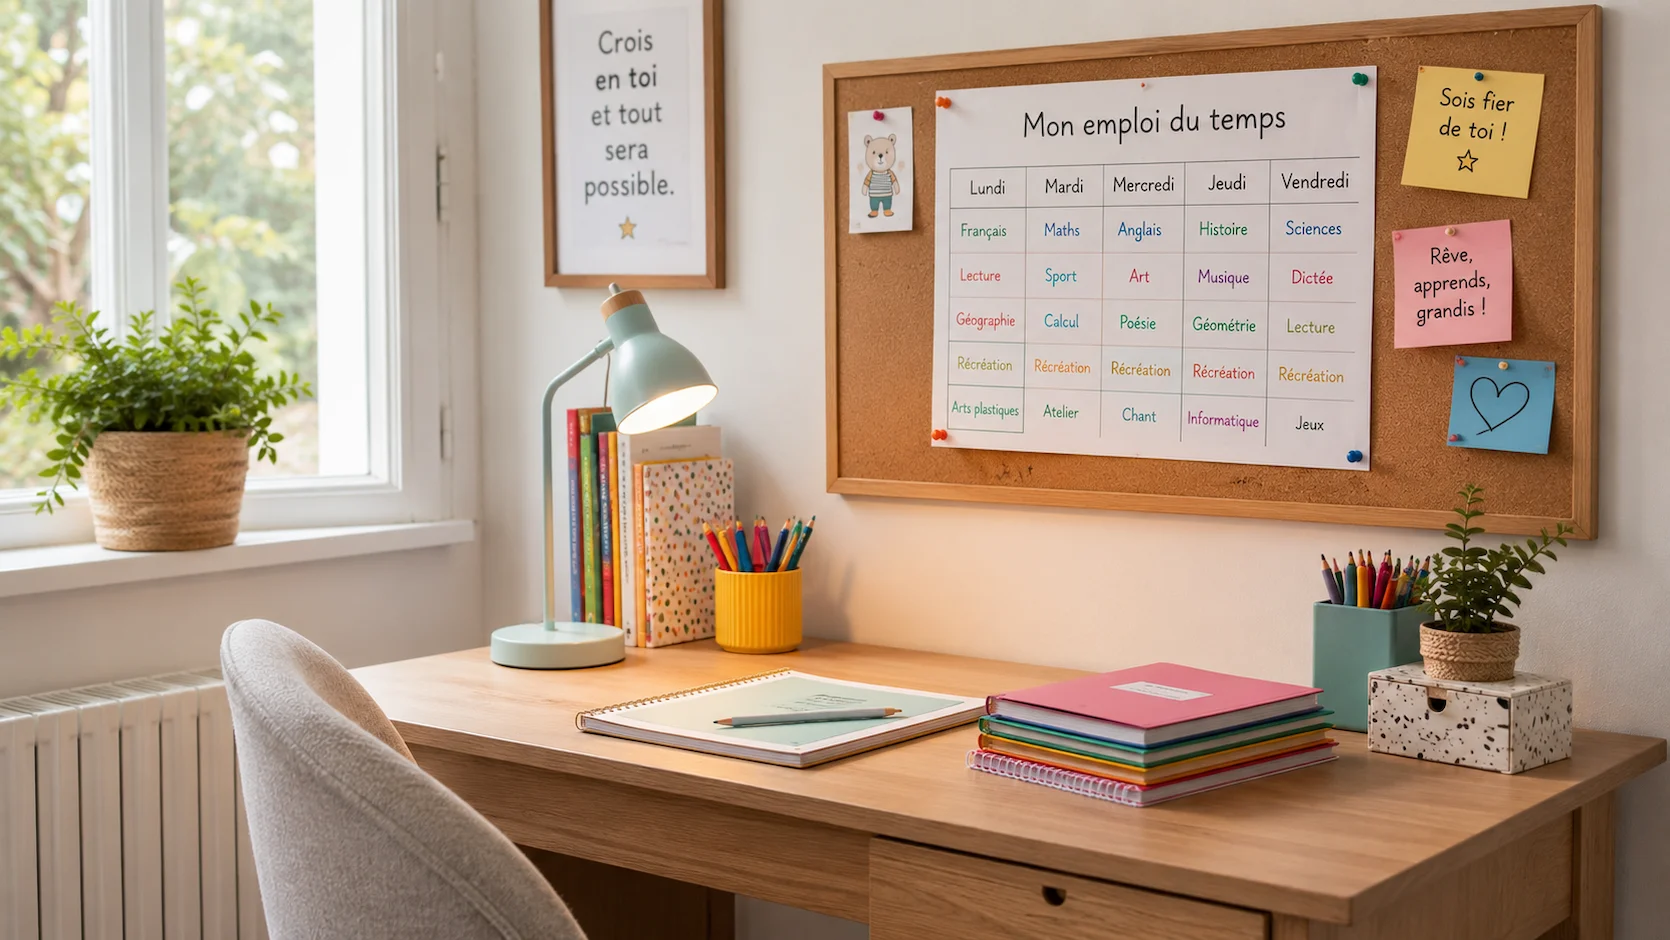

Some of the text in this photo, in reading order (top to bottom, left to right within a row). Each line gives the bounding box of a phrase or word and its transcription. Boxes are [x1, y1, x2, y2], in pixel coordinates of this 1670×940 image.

[598, 29, 653, 55] Crois
[596, 64, 656, 91] en toi
[1440, 88, 1514, 112] Sois fier
[591, 102, 662, 126] et tout
[1024, 104, 1285, 144] Mon emploi du temps
[1440, 116, 1507, 141] de toi !
[606, 143, 648, 161] sera
[585, 170, 674, 205] possible.
[971, 179, 1004, 195] Lundi
[1046, 177, 1083, 193] Mardi
[1114, 176, 1174, 192] Mercredi
[1208, 173, 1245, 190] Jeudi
[1282, 171, 1348, 189] Vendredi
[961, 223, 1006, 241] Français
[1045, 222, 1080, 236] Maths
[1118, 221, 1161, 242] Anglais
[1200, 221, 1247, 235] Histoire
[1286, 220, 1341, 235] Sciences
[1431, 247, 1472, 264] Rêve,
[960, 268, 1000, 281] Lecture
[1046, 268, 1076, 287] Sport
[1129, 269, 1149, 283] Art
[1199, 269, 1249, 289] Musique
[1292, 270, 1333, 284] Dictée
[1414, 270, 1491, 298] apprends,
[1417, 297, 1486, 326] grandis !
[956, 312, 1016, 331] Géographie
[1044, 313, 1079, 328] Calcul
[1120, 315, 1156, 329] Poésie
[1193, 316, 1255, 332] Géométrie
[1287, 318, 1335, 334] Lecture
[958, 356, 1012, 371] Récréation
[1035, 359, 1090, 373] Récréation
[1112, 361, 1170, 376] Récréation
[1194, 364, 1254, 379] Récréation
[1279, 366, 1344, 382] Récréation
[952, 401, 1019, 420] Arts plastiques
[1043, 404, 1079, 418] Atelier
[1123, 407, 1156, 422] Chant
[1187, 411, 1259, 430] Informatique
[1296, 416, 1323, 430] Jeux
